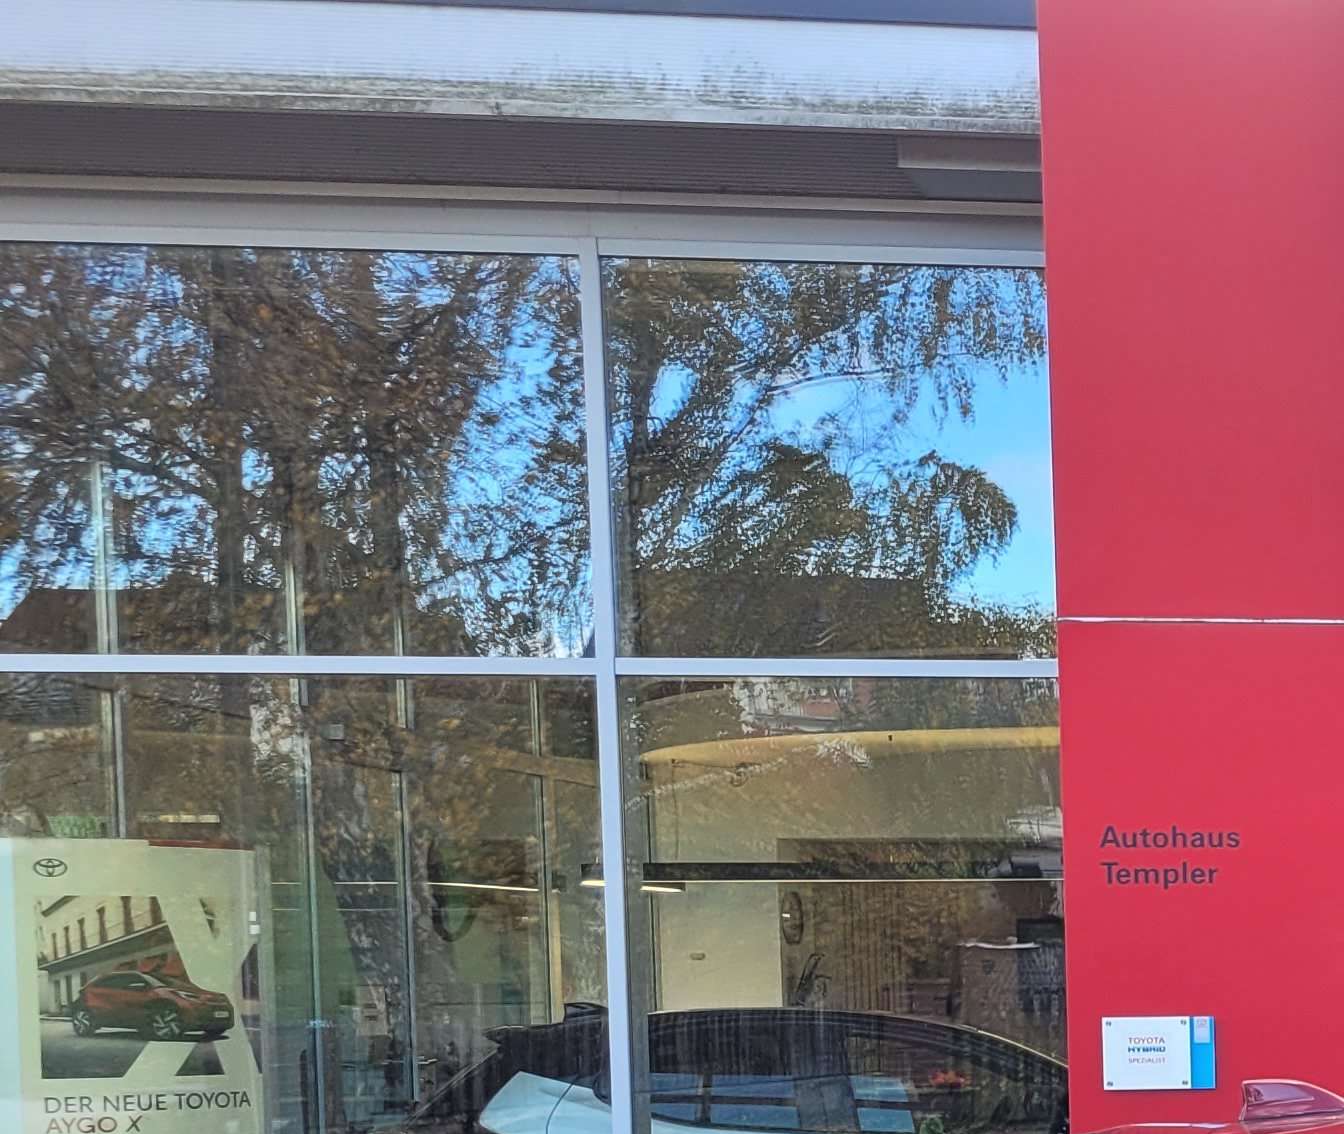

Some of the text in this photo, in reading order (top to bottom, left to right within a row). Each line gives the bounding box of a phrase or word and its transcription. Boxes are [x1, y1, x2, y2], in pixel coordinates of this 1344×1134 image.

[1100, 825, 1241, 848] Autohaus
[1100, 860, 1219, 890] Templer
[1128, 1036, 1166, 1045] TOYOTA
[44, 1090, 252, 1114] DER NEUE TOYOTA
[45, 1114, 143, 1134] AYGO X
